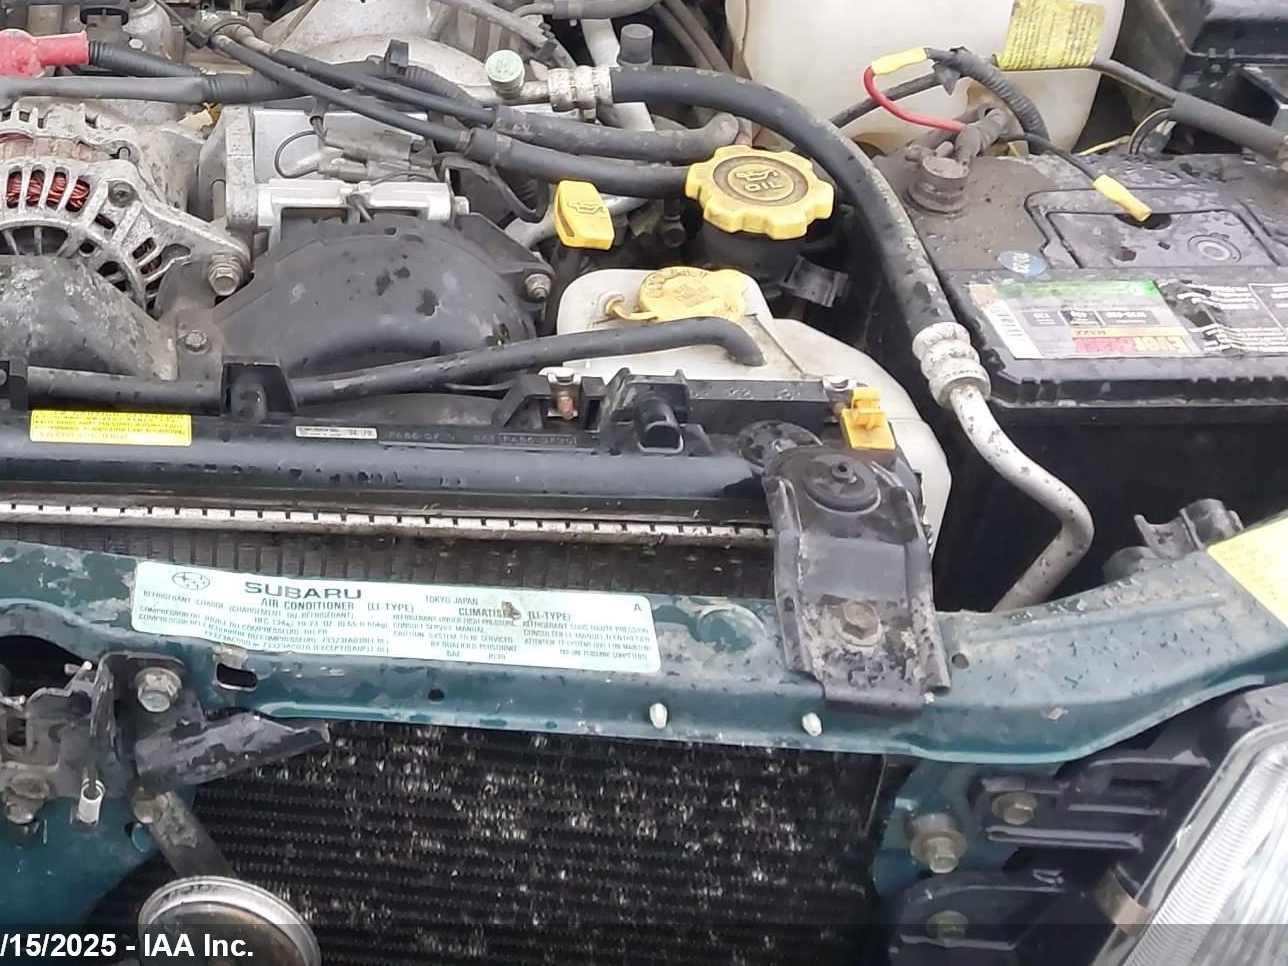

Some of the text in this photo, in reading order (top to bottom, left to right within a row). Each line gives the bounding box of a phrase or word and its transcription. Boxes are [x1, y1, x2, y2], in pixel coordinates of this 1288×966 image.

[744, 180, 784, 192] OIL
[244, 581, 362, 600] SUBARU
[261, 597, 279, 609] AIR
[284, 601, 354, 611] CONDITIONER
[453, 596, 479, 606] JAPAN
[633, 603, 643, 612] A
